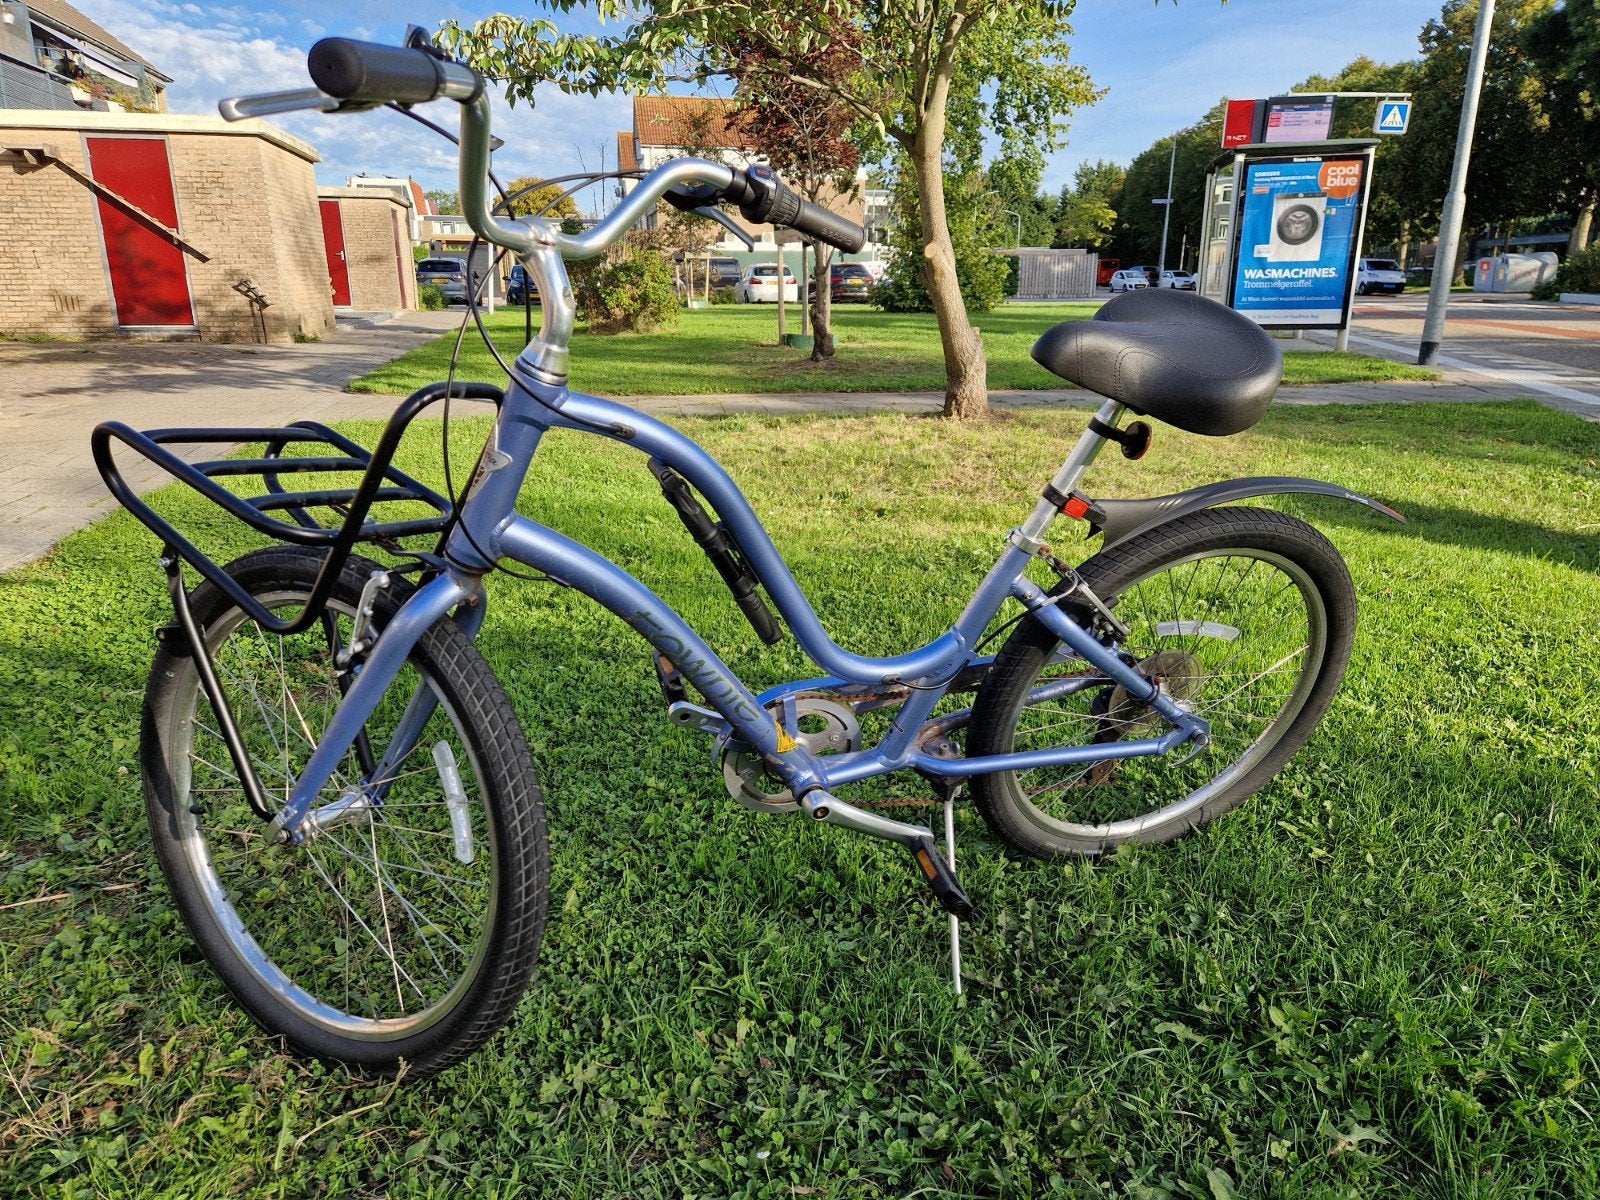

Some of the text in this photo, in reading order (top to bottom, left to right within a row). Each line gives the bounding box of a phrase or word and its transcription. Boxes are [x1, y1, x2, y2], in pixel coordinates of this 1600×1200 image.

[1327, 164, 1360, 176] cool
[1326, 175, 1358, 187] blue
[630, 610, 761, 722] townie
